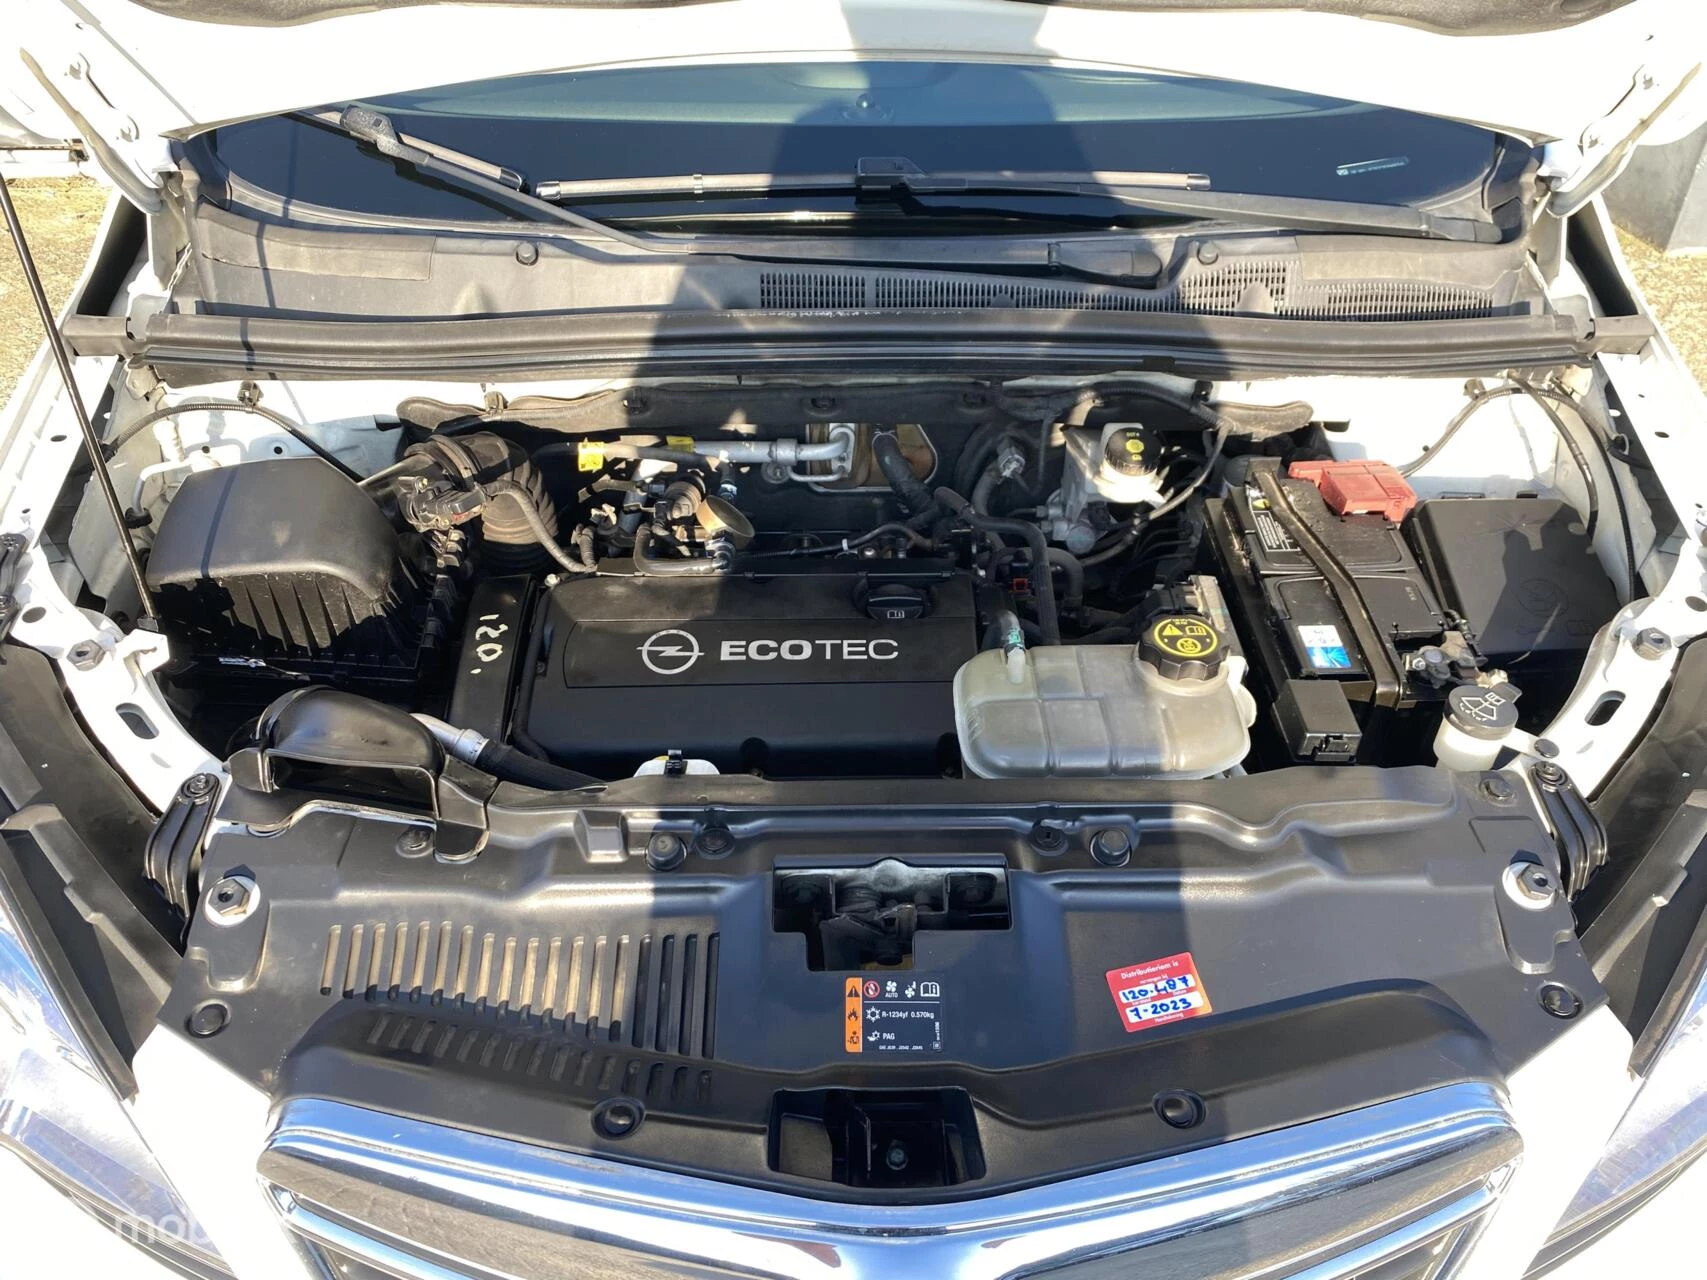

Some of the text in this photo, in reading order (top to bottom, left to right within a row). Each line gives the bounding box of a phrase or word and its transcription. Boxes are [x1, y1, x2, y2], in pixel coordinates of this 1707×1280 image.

[720, 639, 899, 661] ECOTEC
[881, 1011, 935, 1019] R-1234yf 0.570kg
